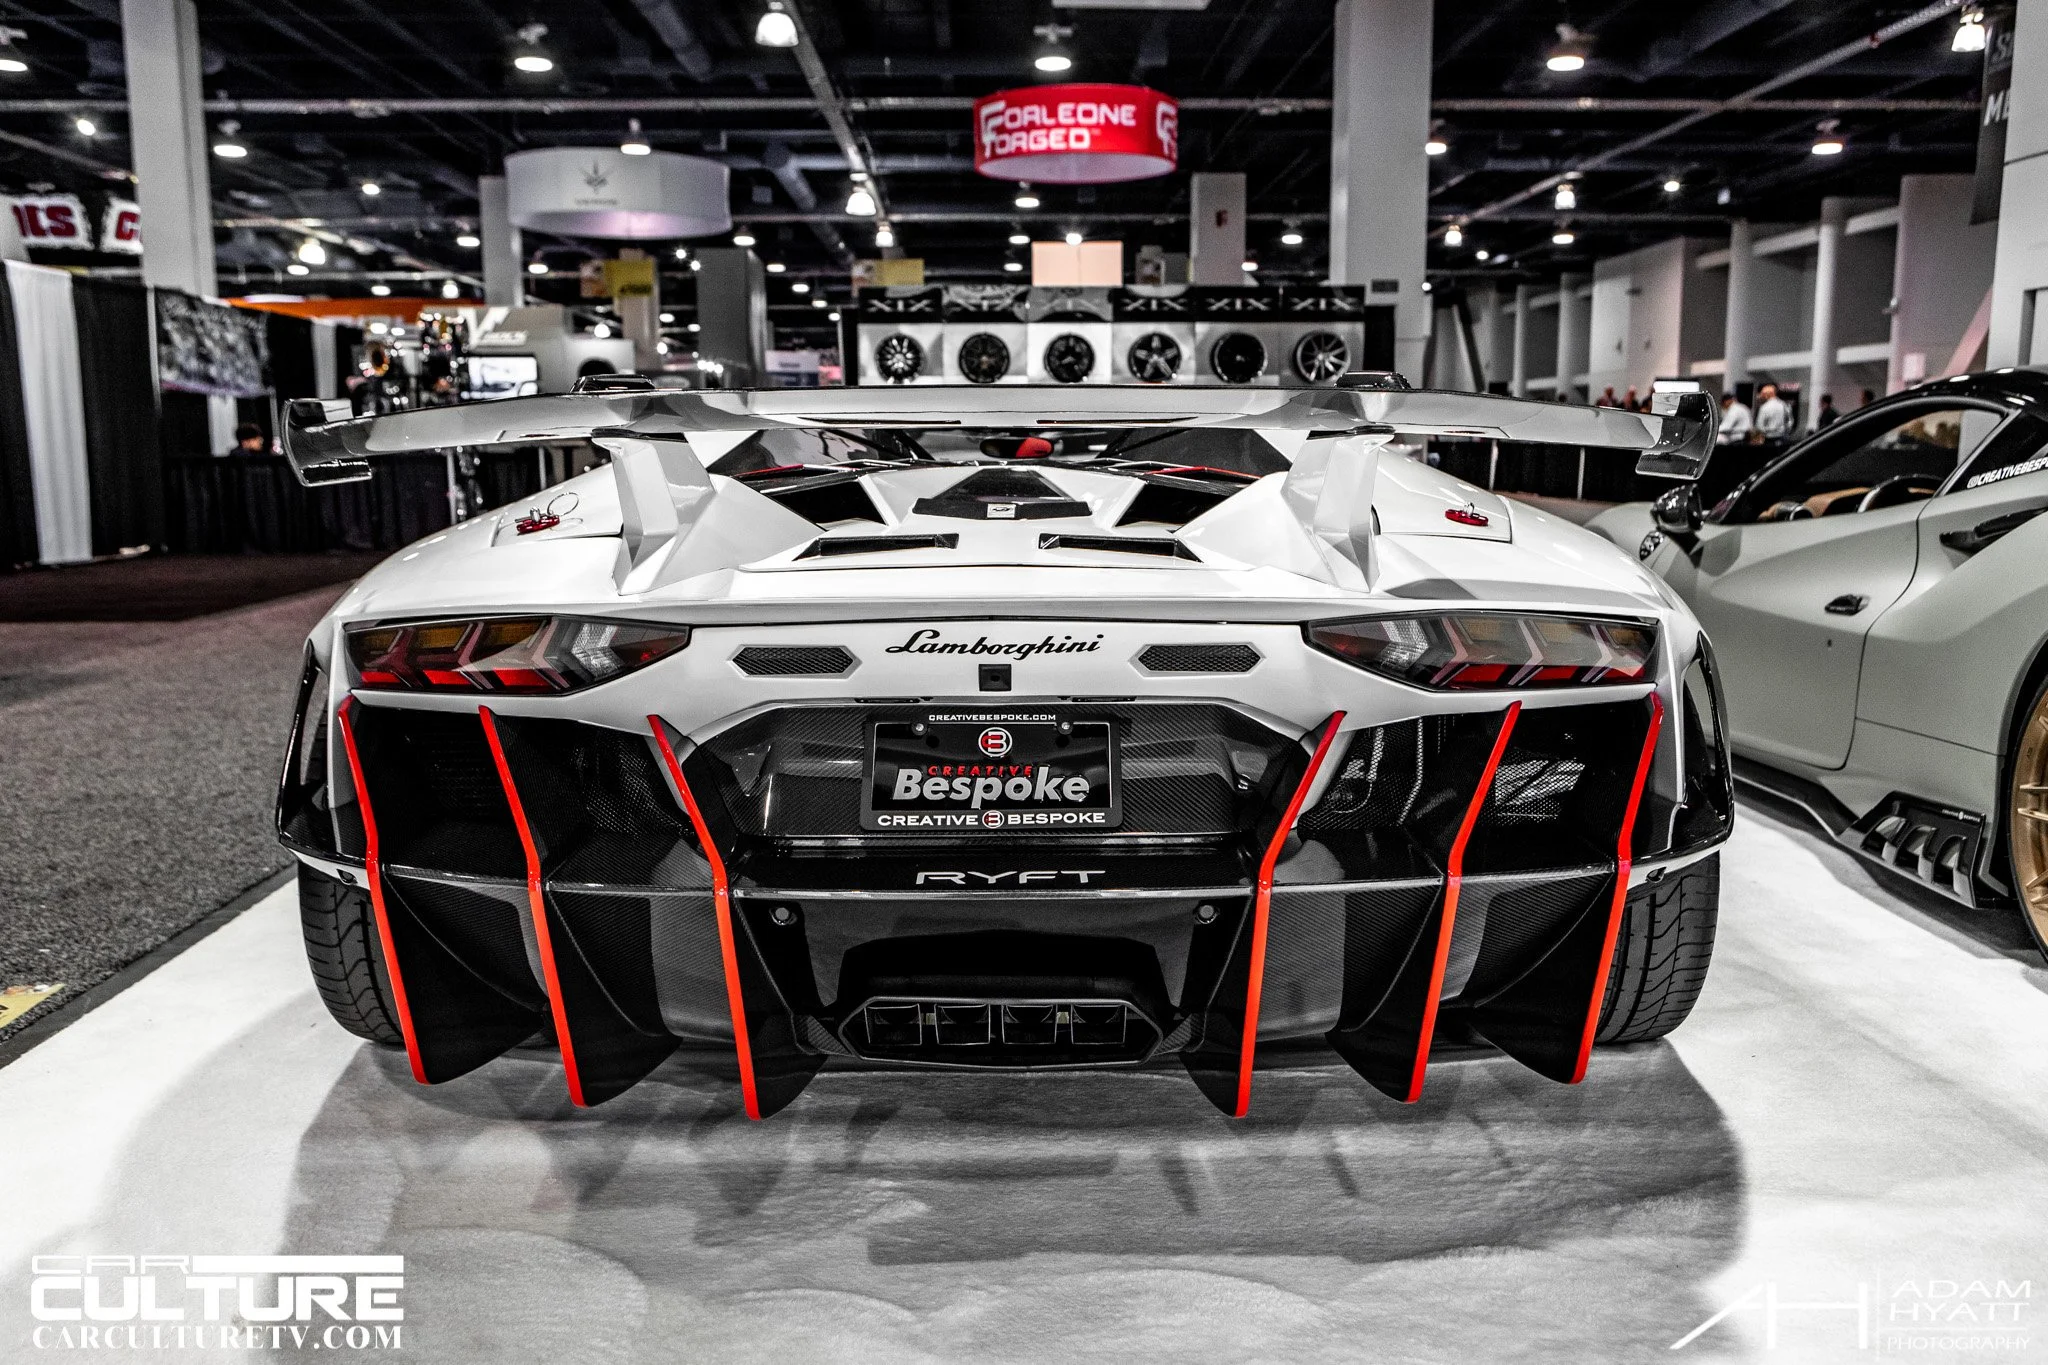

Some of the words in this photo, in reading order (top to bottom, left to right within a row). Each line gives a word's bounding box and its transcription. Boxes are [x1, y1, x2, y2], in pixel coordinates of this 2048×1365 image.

[885, 629, 1104, 661] Lamborghini
[928, 765, 1032, 777] CREATIVE
[893, 766, 1090, 810] Bespoke
[878, 814, 978, 826] CREATIVE
[1007, 812, 1105, 825] BESPOKE
[916, 870, 1105, 884] RYFT
